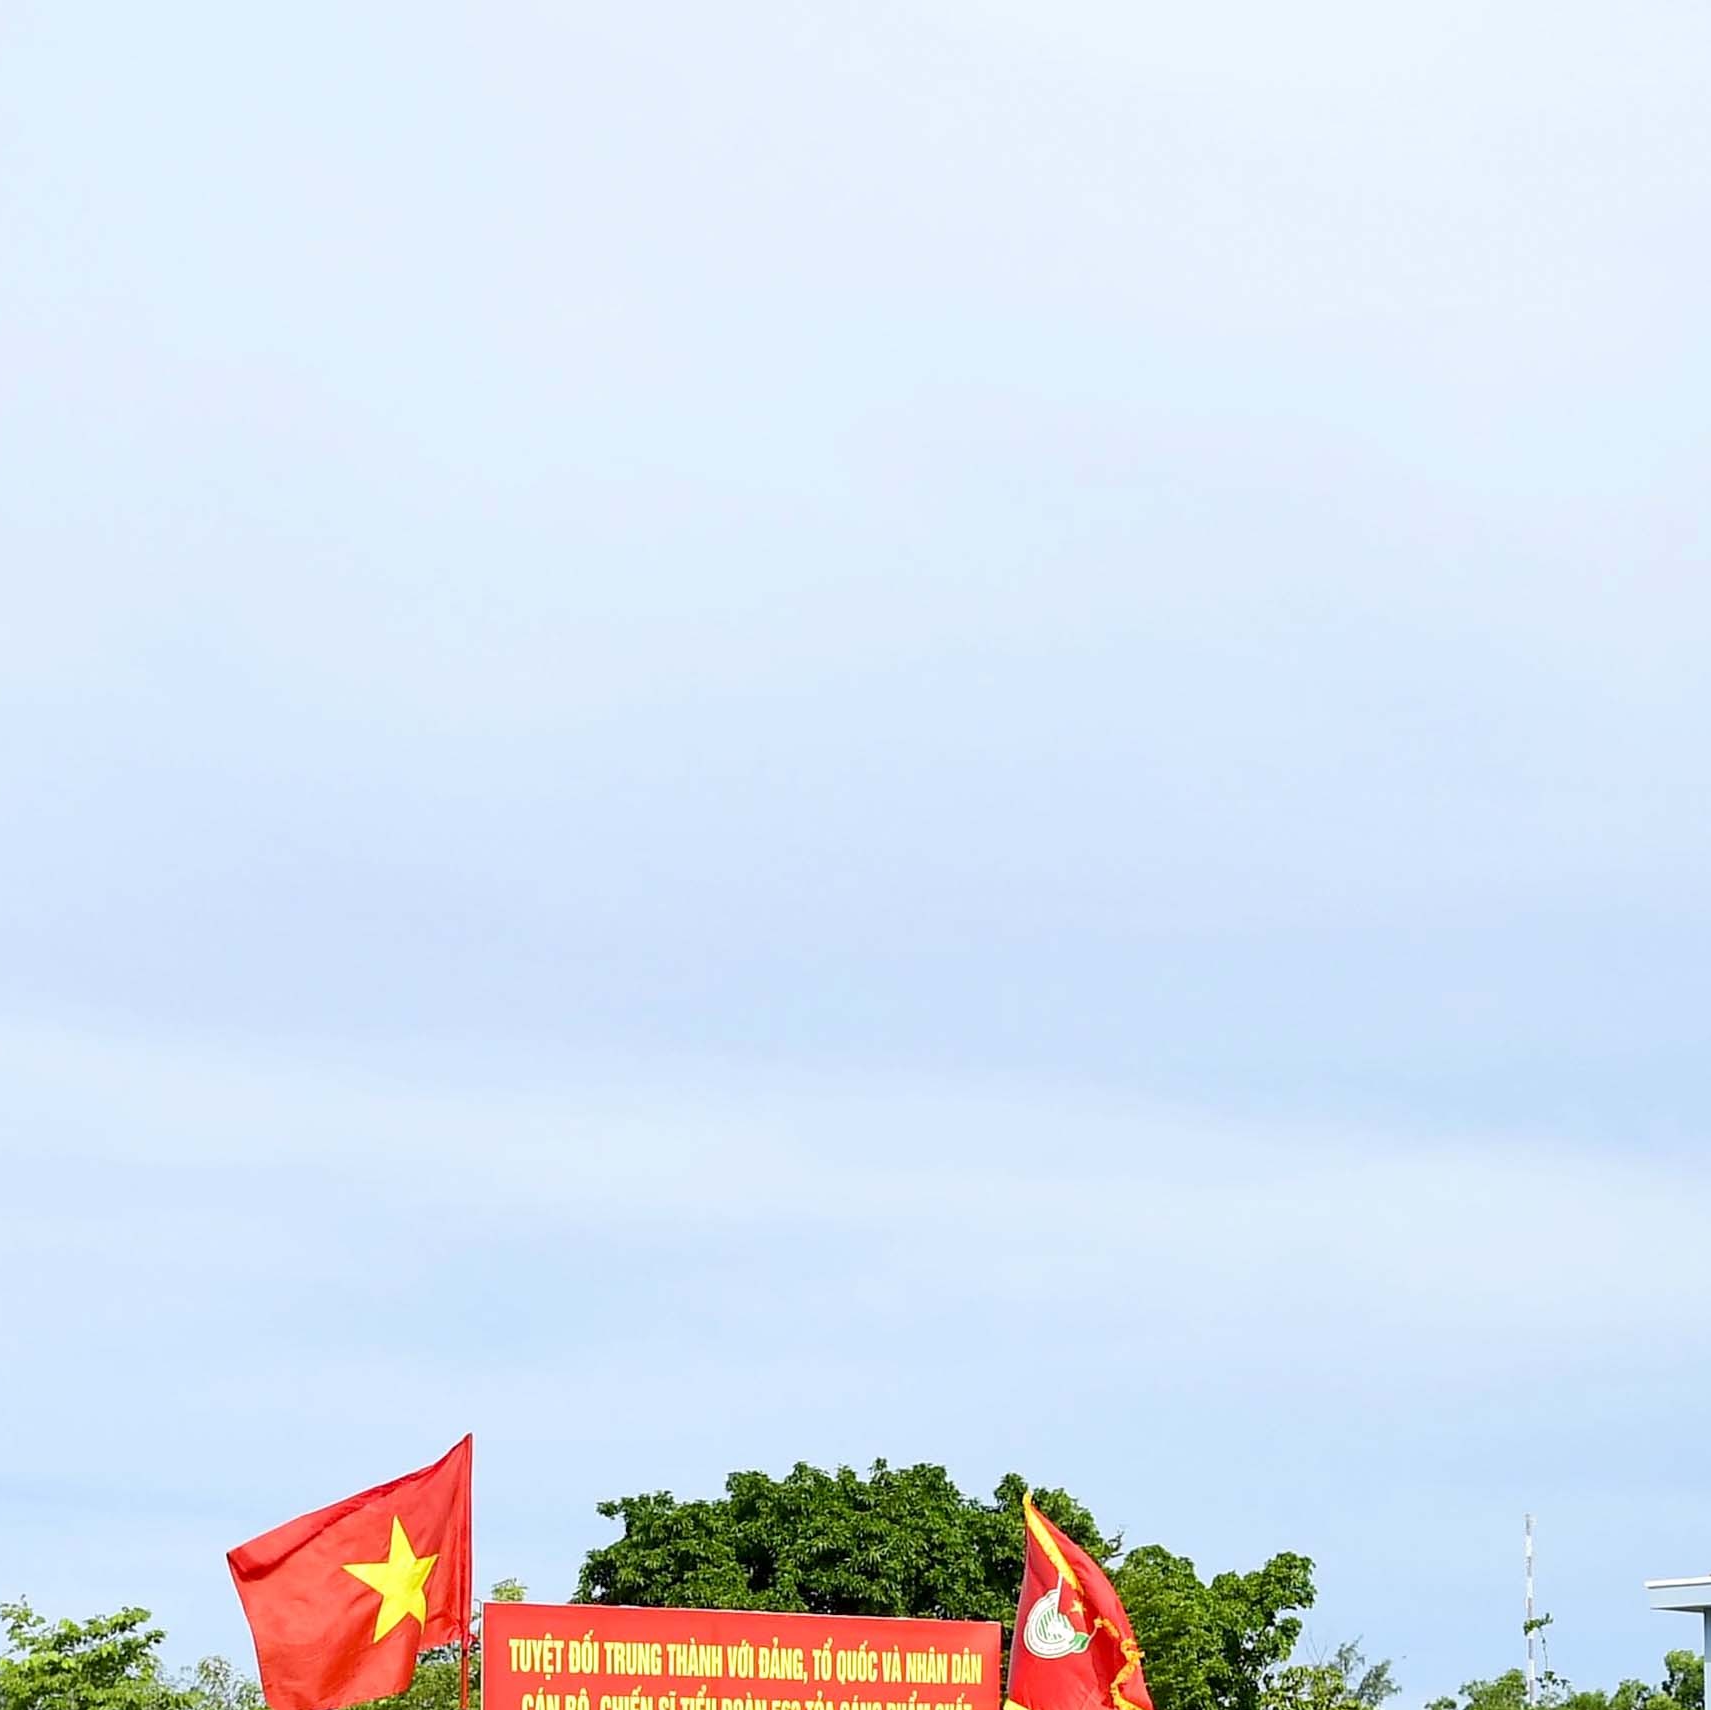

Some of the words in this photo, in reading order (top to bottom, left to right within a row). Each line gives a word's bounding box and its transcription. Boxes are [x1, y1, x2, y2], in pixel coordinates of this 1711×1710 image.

[508, 1632, 565, 1681] TUYỆT
[567, 1629, 600, 1675] ĐỐI
[603, 1641, 663, 1676] TRUNG
[666, 1637, 724, 1678] THÀNH
[726, 1639, 755, 1679] VỚI
[757, 1636, 809, 1684] ĐẢNG,
[811, 1636, 834, 1681] TỔ
[835, 1639, 879, 1685] QUỐC
[881, 1644, 903, 1683] VÀ
[905, 1646, 949, 1685] NHÂN
[950, 1647, 983, 1685] DÂN
